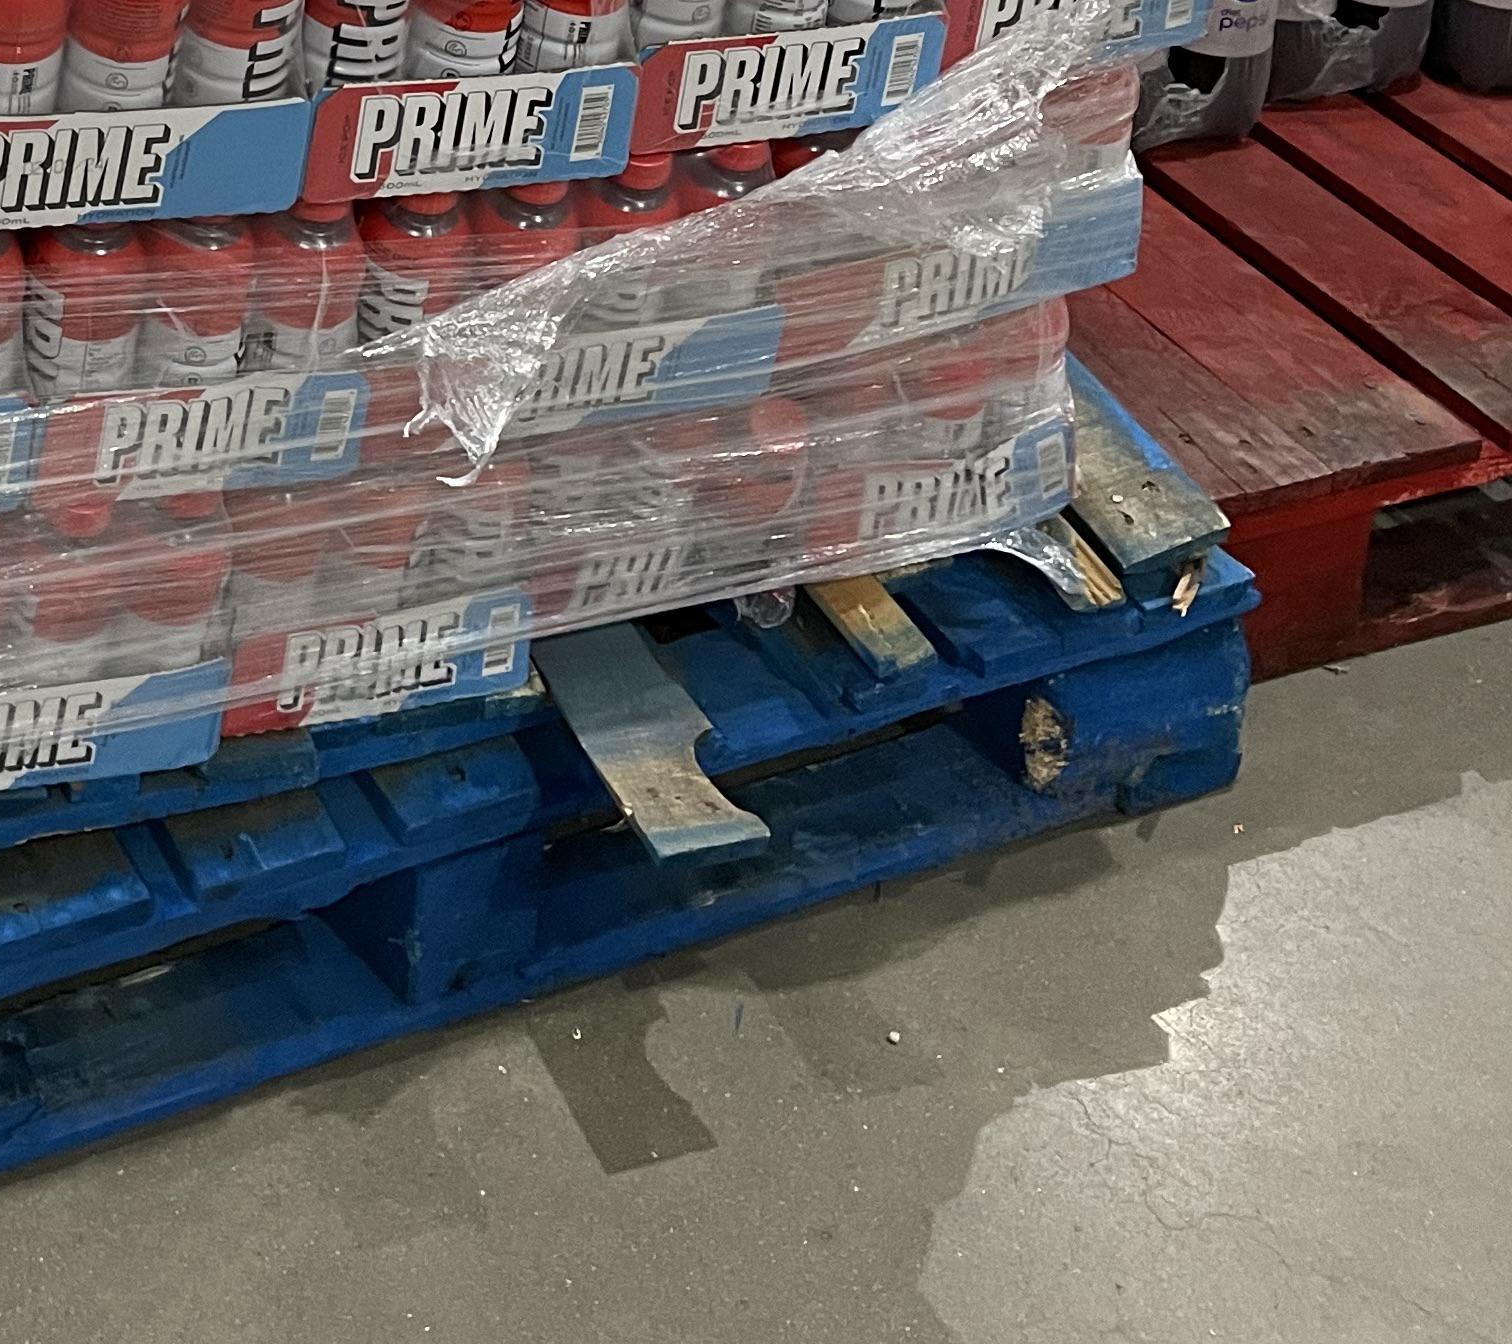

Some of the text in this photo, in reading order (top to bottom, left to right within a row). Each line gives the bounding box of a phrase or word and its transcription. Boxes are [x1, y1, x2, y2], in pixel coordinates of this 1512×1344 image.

[675, 36, 866, 131] PRIME
[353, 86, 556, 182] PRIME
[890, 240, 1034, 328] PRIME
[95, 385, 289, 486] PRIME
